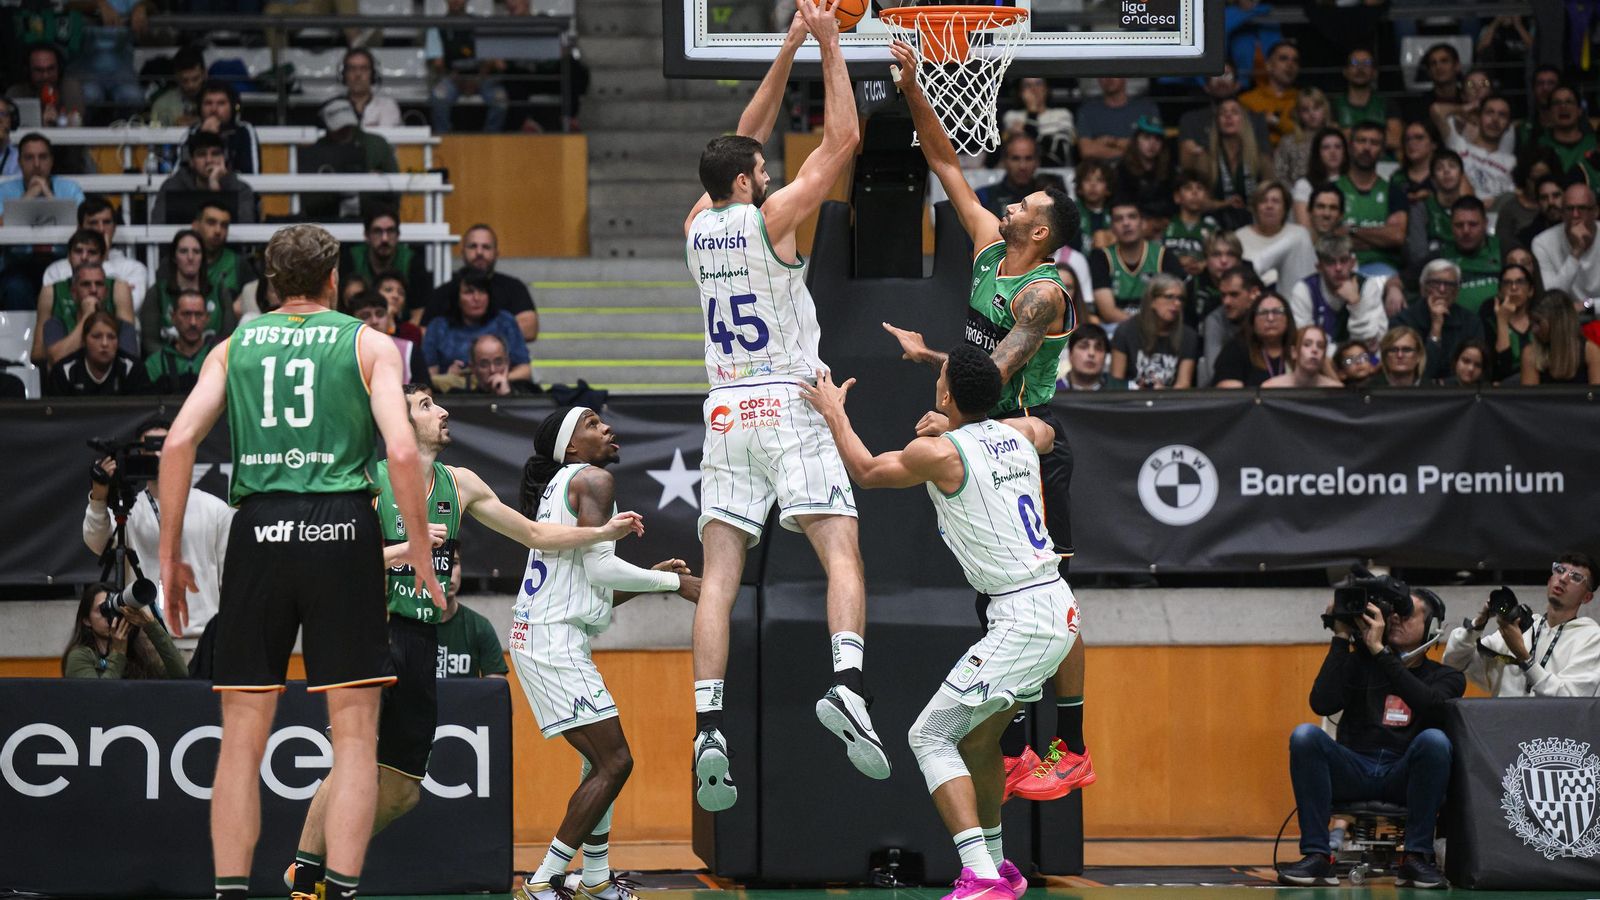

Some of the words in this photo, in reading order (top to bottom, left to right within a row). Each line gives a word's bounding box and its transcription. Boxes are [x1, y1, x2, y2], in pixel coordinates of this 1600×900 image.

[1121, 0, 1146, 14] liga
[1121, 13, 1176, 25] endesa
[693, 231, 747, 250] Kravish
[708, 293, 770, 354] 45
[241, 325, 340, 347] PUSTOVYI
[260, 356, 315, 428] 13
[739, 398, 782, 411] COSTA
[740, 410, 758, 421] DEL
[759, 408, 782, 419] SOL
[239, 453, 284, 465] ADALONA
[305, 452, 336, 464] FUTUR
[979, 438, 1019, 460] Tyson
[1240, 466, 1407, 496] Barcelona
[1417, 464, 1564, 494] Premium
[253, 520, 294, 543] vdf
[297, 520, 356, 542] team
[1017, 494, 1047, 550] 0
[447, 653, 472, 674] 30
[0, 722, 490, 801] enea
